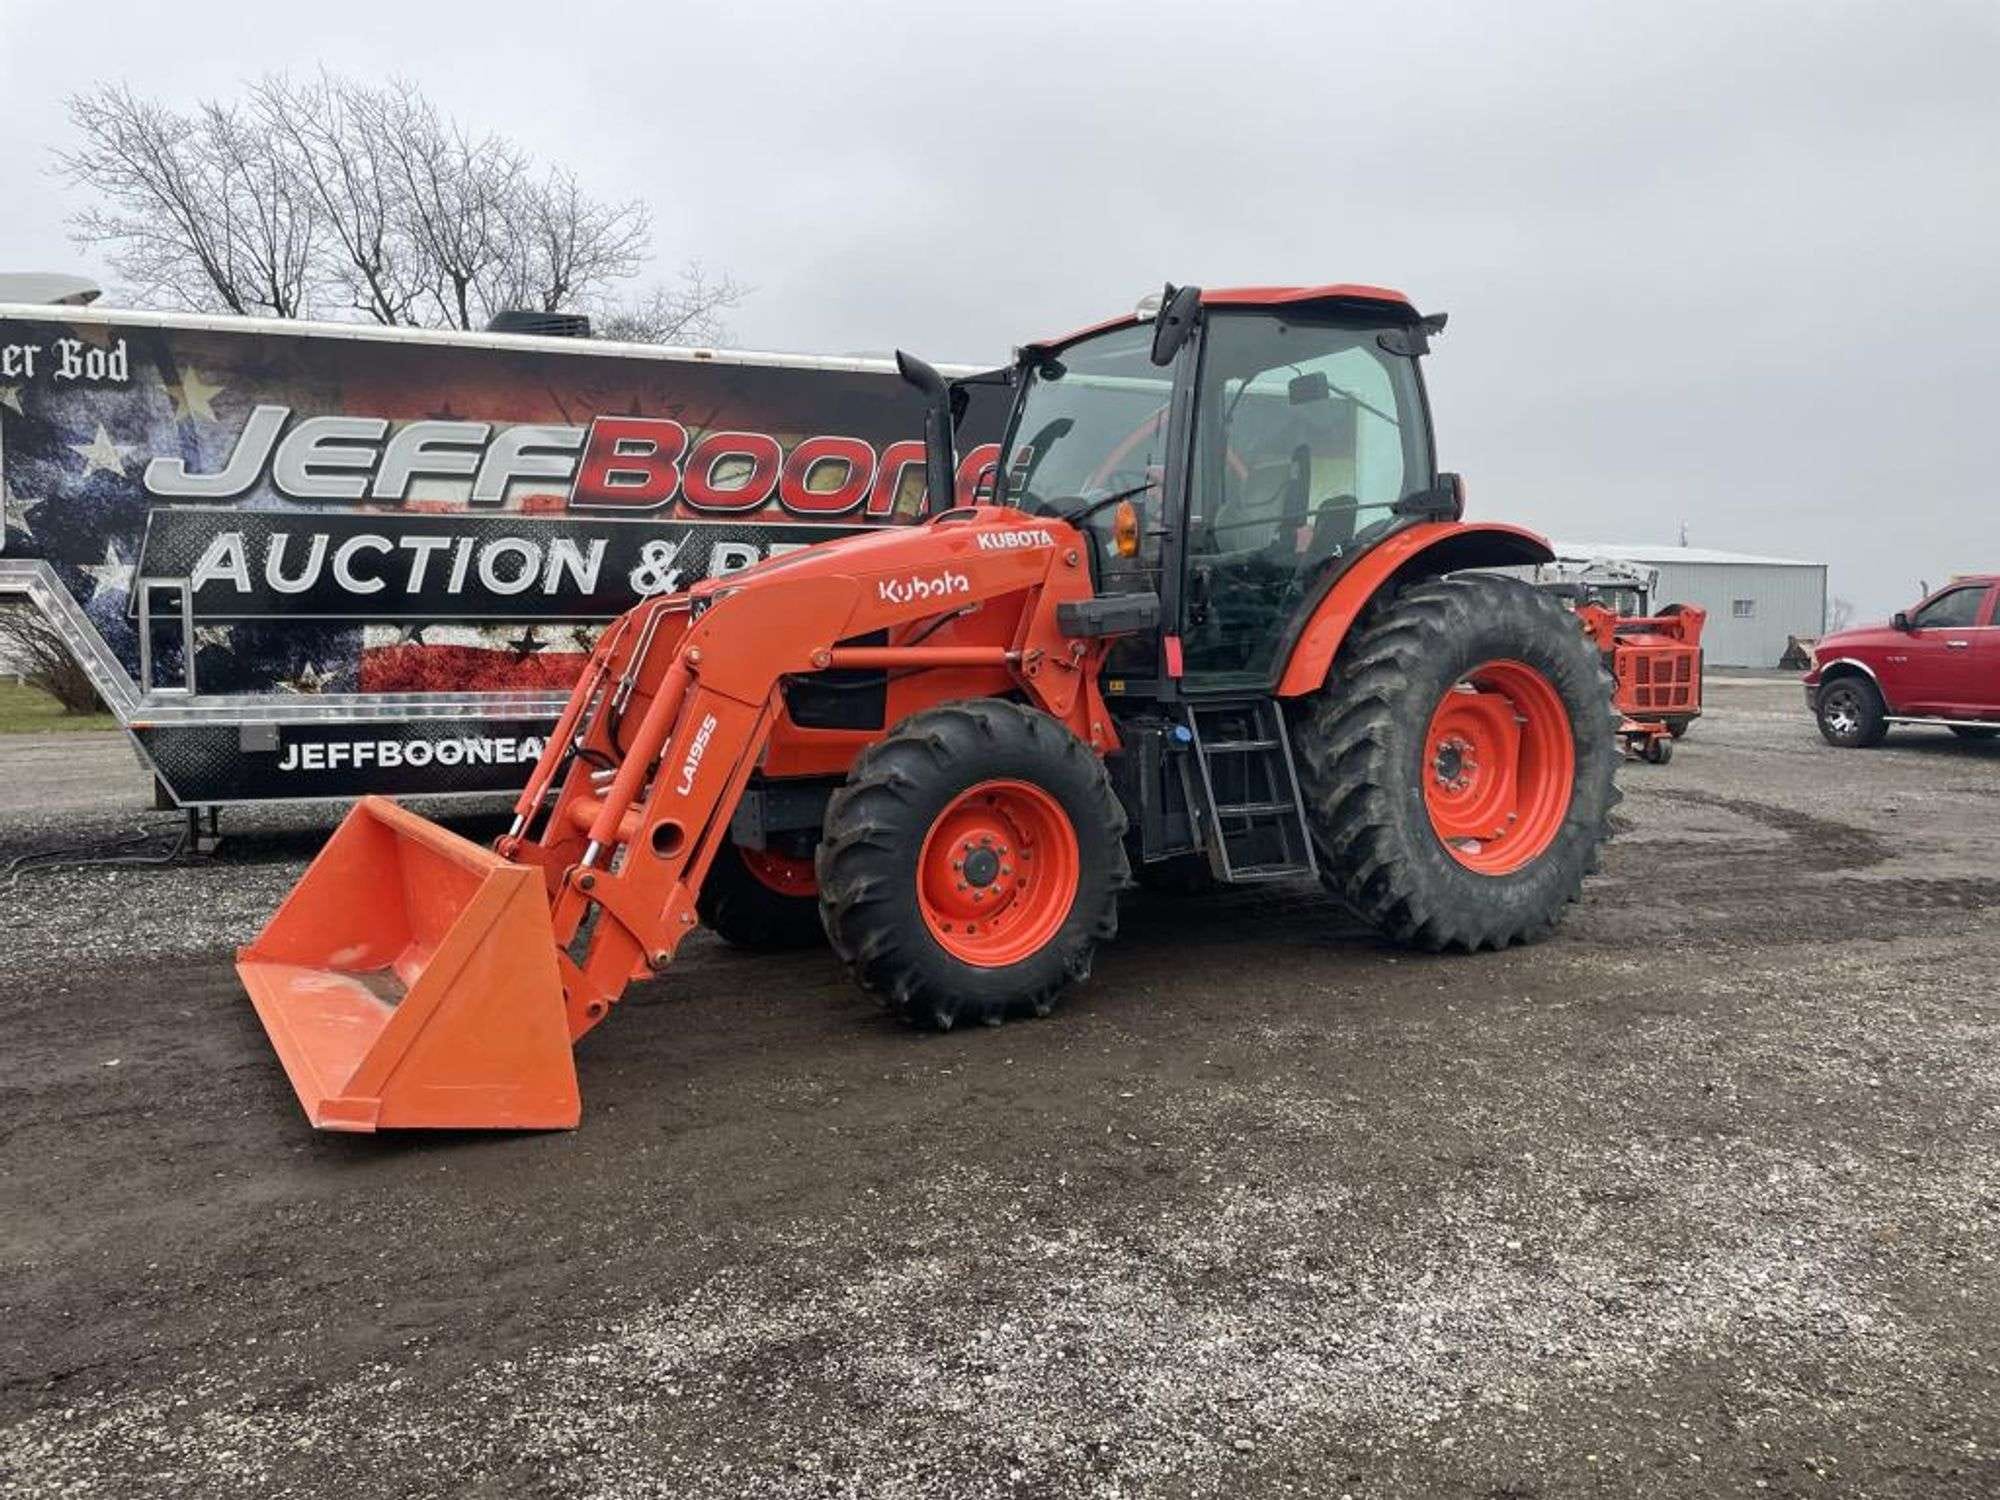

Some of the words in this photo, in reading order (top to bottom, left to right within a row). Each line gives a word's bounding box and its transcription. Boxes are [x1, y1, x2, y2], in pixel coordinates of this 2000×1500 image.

[977, 529, 1053, 550] KUBOTA
[192, 532, 609, 595] AUCTION
[630, 539, 692, 595] &
[878, 571, 970, 603] Kubota
[278, 737, 551, 771] JEFFBOONEA
[677, 713, 717, 796] LA1955
